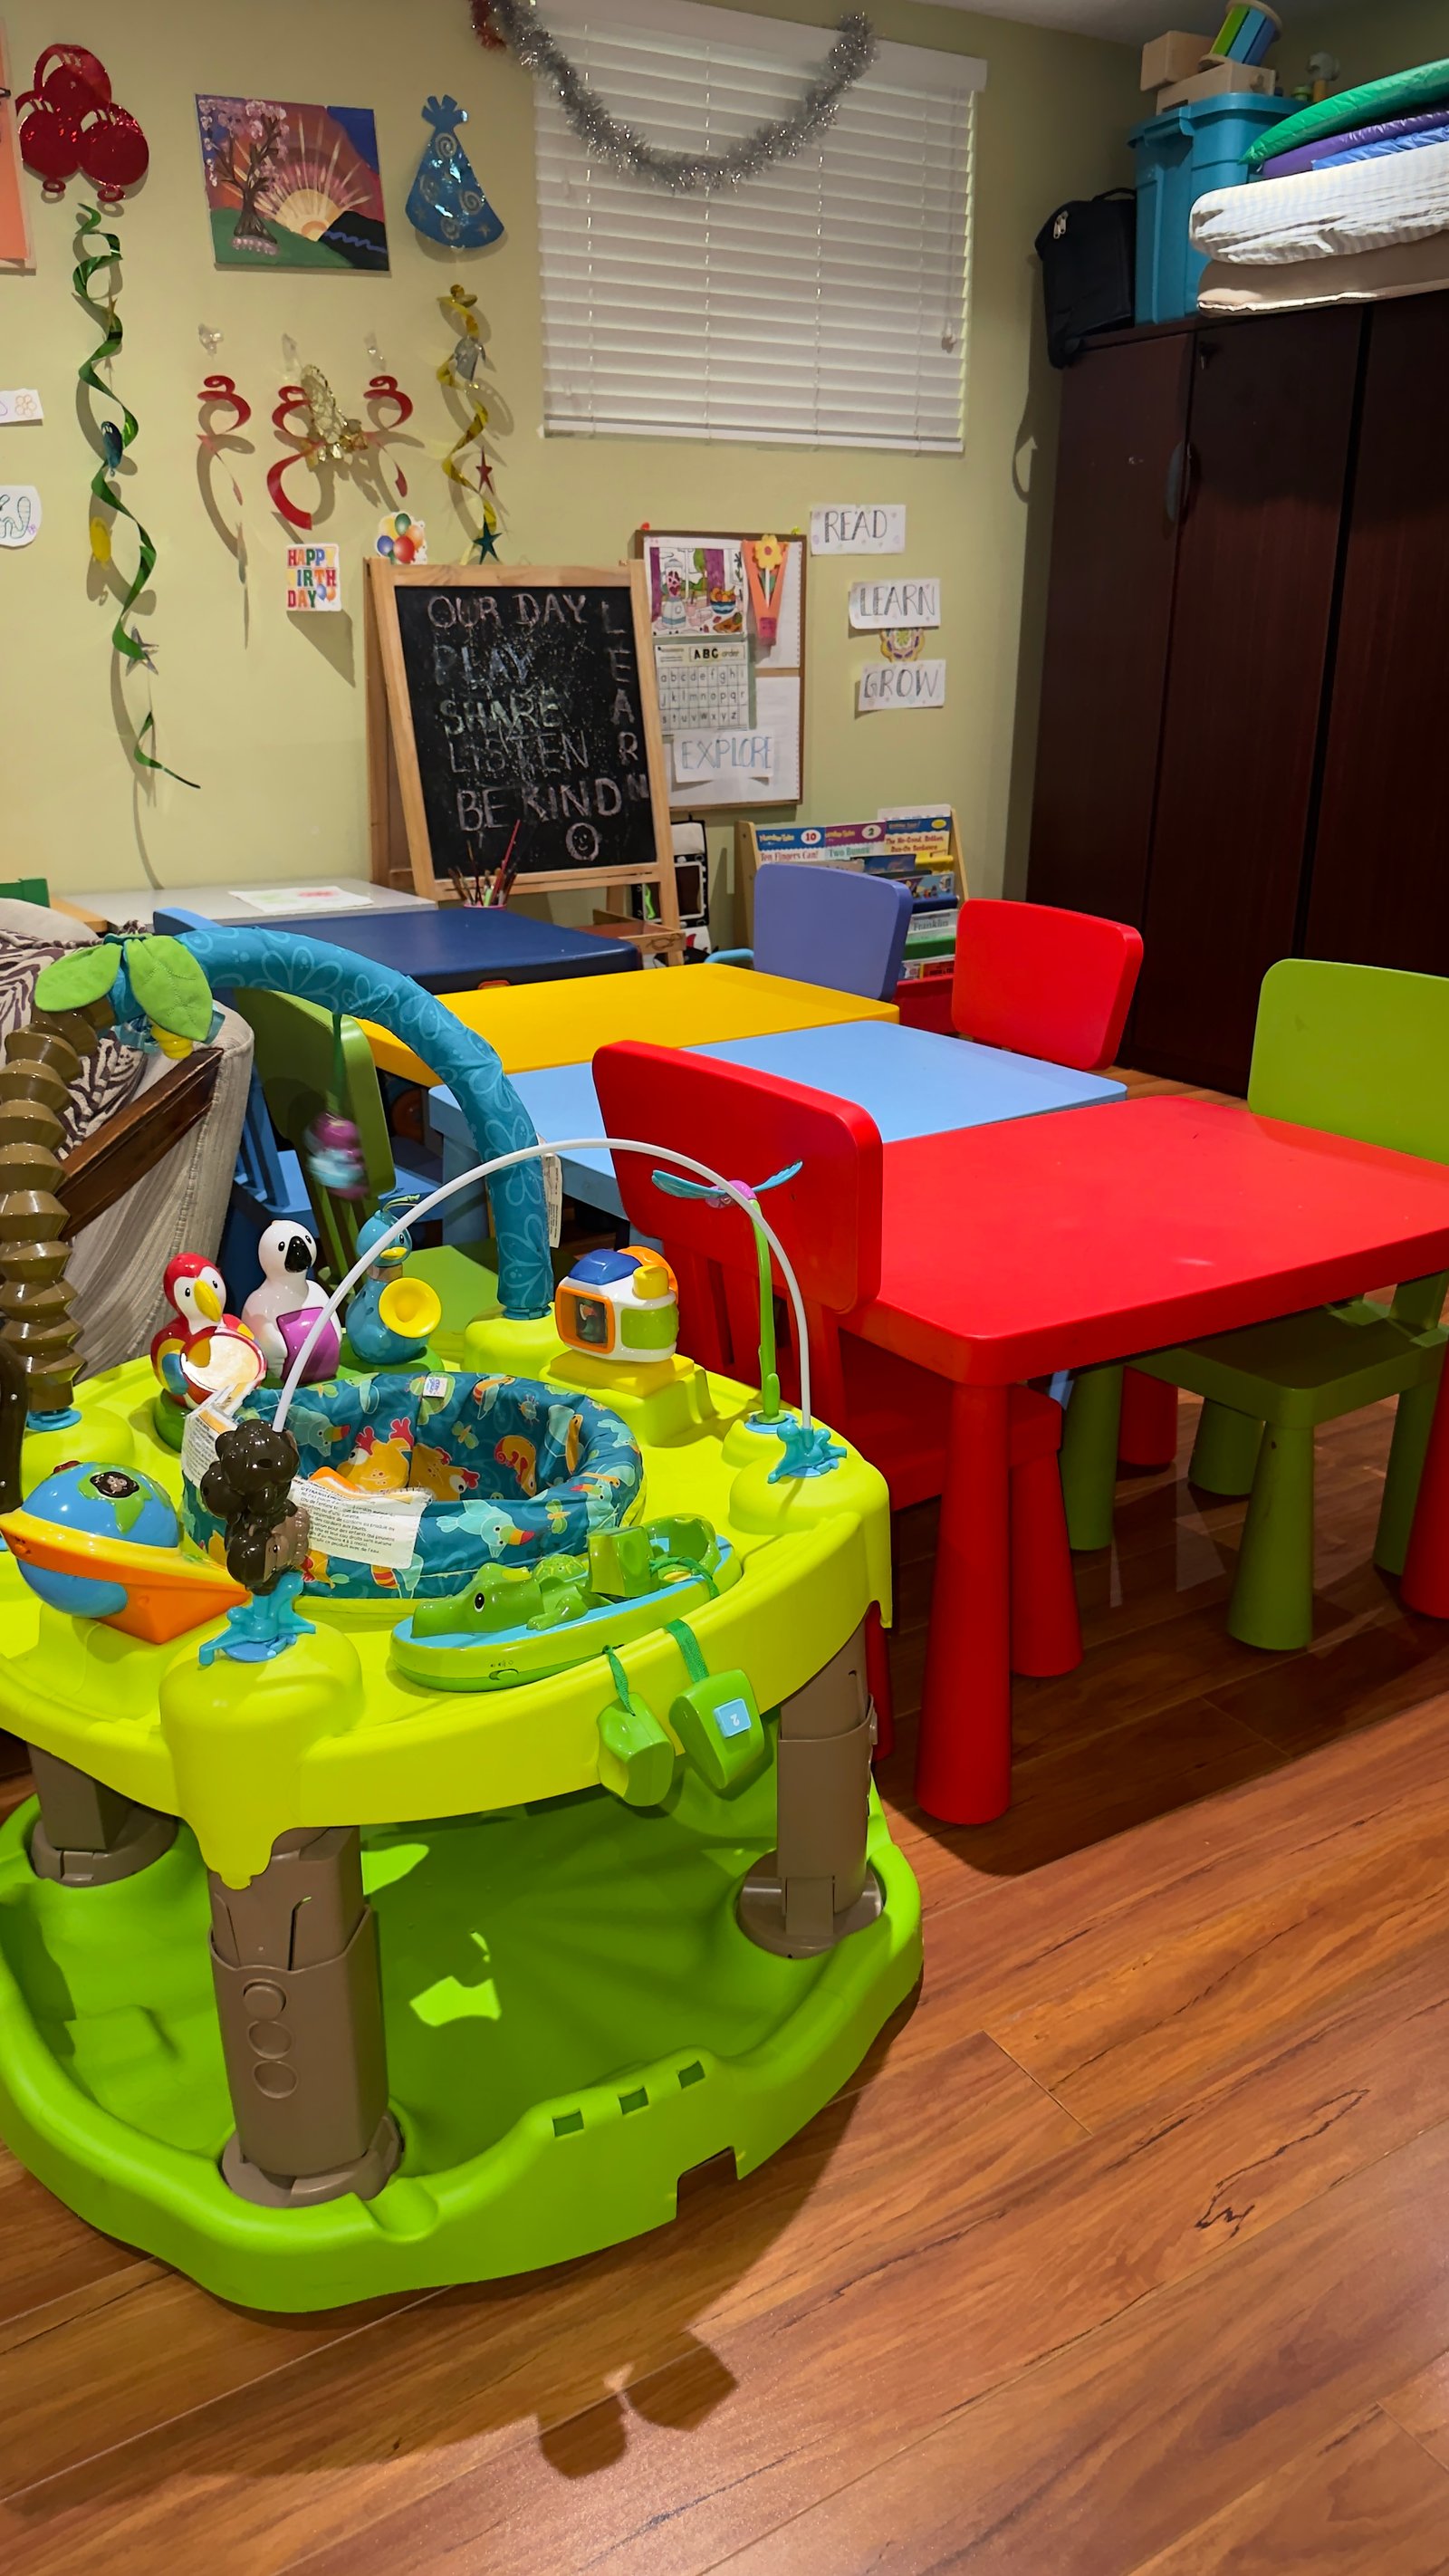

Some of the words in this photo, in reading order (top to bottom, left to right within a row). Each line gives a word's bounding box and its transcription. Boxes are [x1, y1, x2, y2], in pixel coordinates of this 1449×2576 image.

[823, 509, 888, 543] READ
[288, 547, 335, 566] HAPPY
[288, 568, 336, 587] BIRTH
[288, 590, 317, 608] DAY
[859, 582, 936, 617] LEARN
[427, 594, 503, 630] OUR
[513, 593, 588, 629] DAY
[694, 648, 719, 659] ABC
[432, 642, 533, 687] PLAY
[864, 668, 940, 699] GROW
[438, 688, 565, 735] SHARE
[444, 727, 590, 774] LISTEN
[681, 736, 772, 771] EXPLORE
[456, 786, 513, 831] BE
[522, 777, 622, 822] KIND
[805, 832, 817, 841] 10
[868, 828, 875, 836] 2
[761, 853, 773, 861] Ten
[774, 851, 801, 860] Fingers
[802, 851, 819, 860] Can!
[829, 849, 844, 858] Two
[913, 918, 949, 931] Franklin
[730, 1713, 740, 1726] 2
